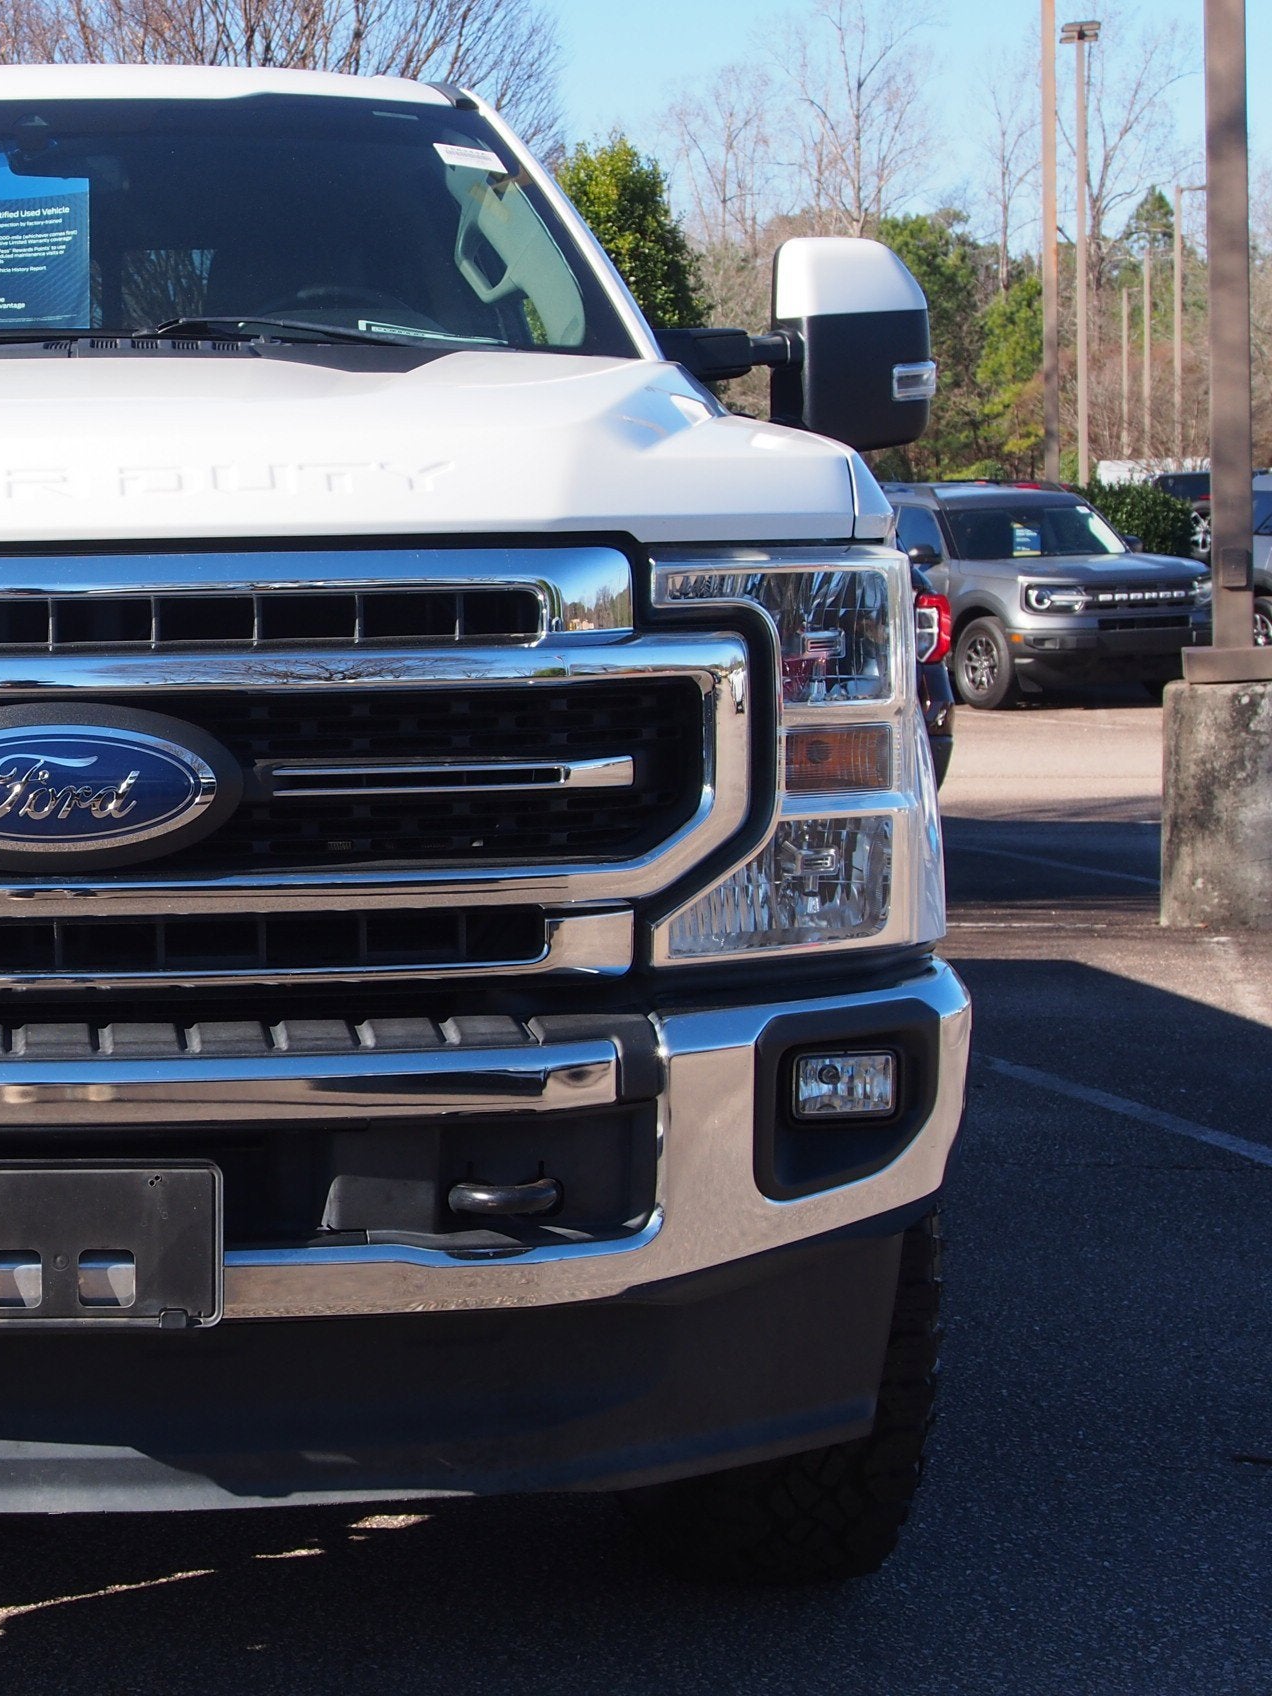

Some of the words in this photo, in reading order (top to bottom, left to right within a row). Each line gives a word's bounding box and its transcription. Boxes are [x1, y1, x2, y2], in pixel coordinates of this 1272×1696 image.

[21, 209, 40, 217] Used
[42, 206, 70, 215] Vehicle
[119, 460, 456, 498] DUTY
[1098, 590, 1186, 602] BRONCO
